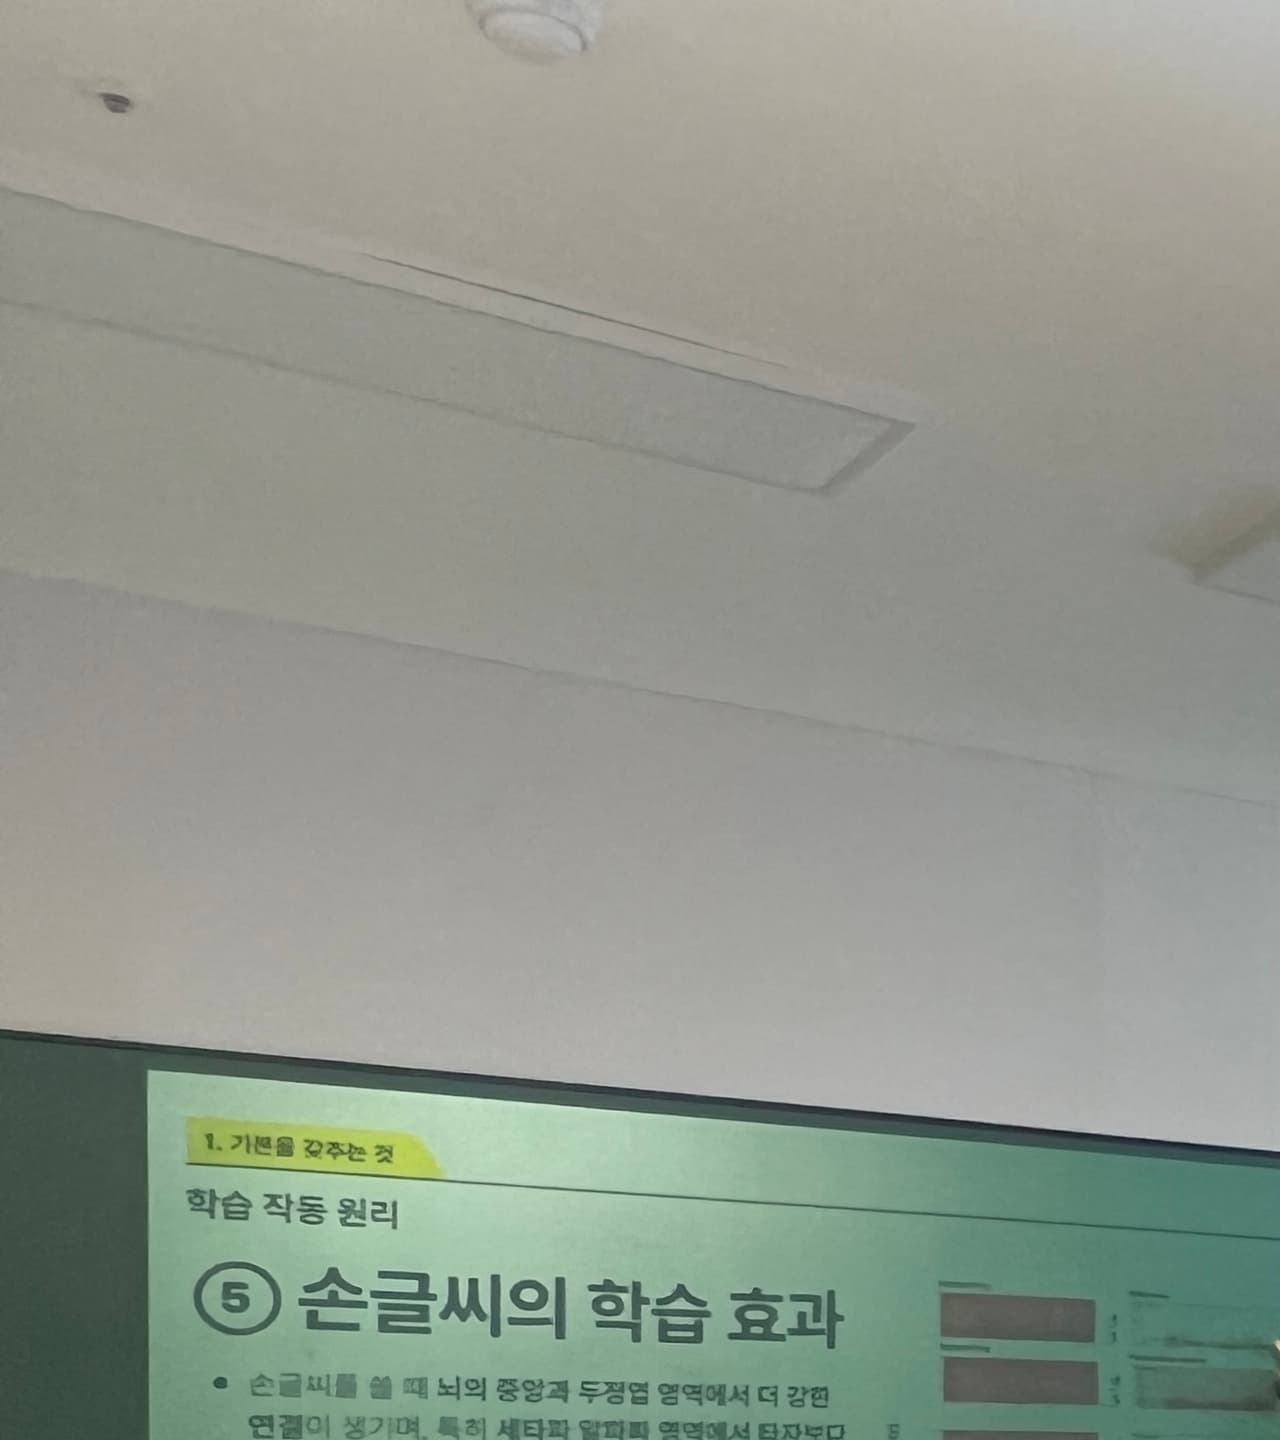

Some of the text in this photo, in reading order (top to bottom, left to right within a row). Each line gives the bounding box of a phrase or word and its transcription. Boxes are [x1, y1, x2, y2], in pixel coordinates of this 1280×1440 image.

[204, 1133, 222, 1151] 1.
[186, 1188, 398, 1230] 학습 작동 원리
[298, 1266, 567, 1340] 손글씨의
[588, 1278, 713, 1345] 학습
[728, 1286, 845, 1350] 효과
[250, 1372, 357, 1399] 손글씨
[437, 1375, 487, 1401] 뇌의
[758, 1385, 778, 1407] 더
